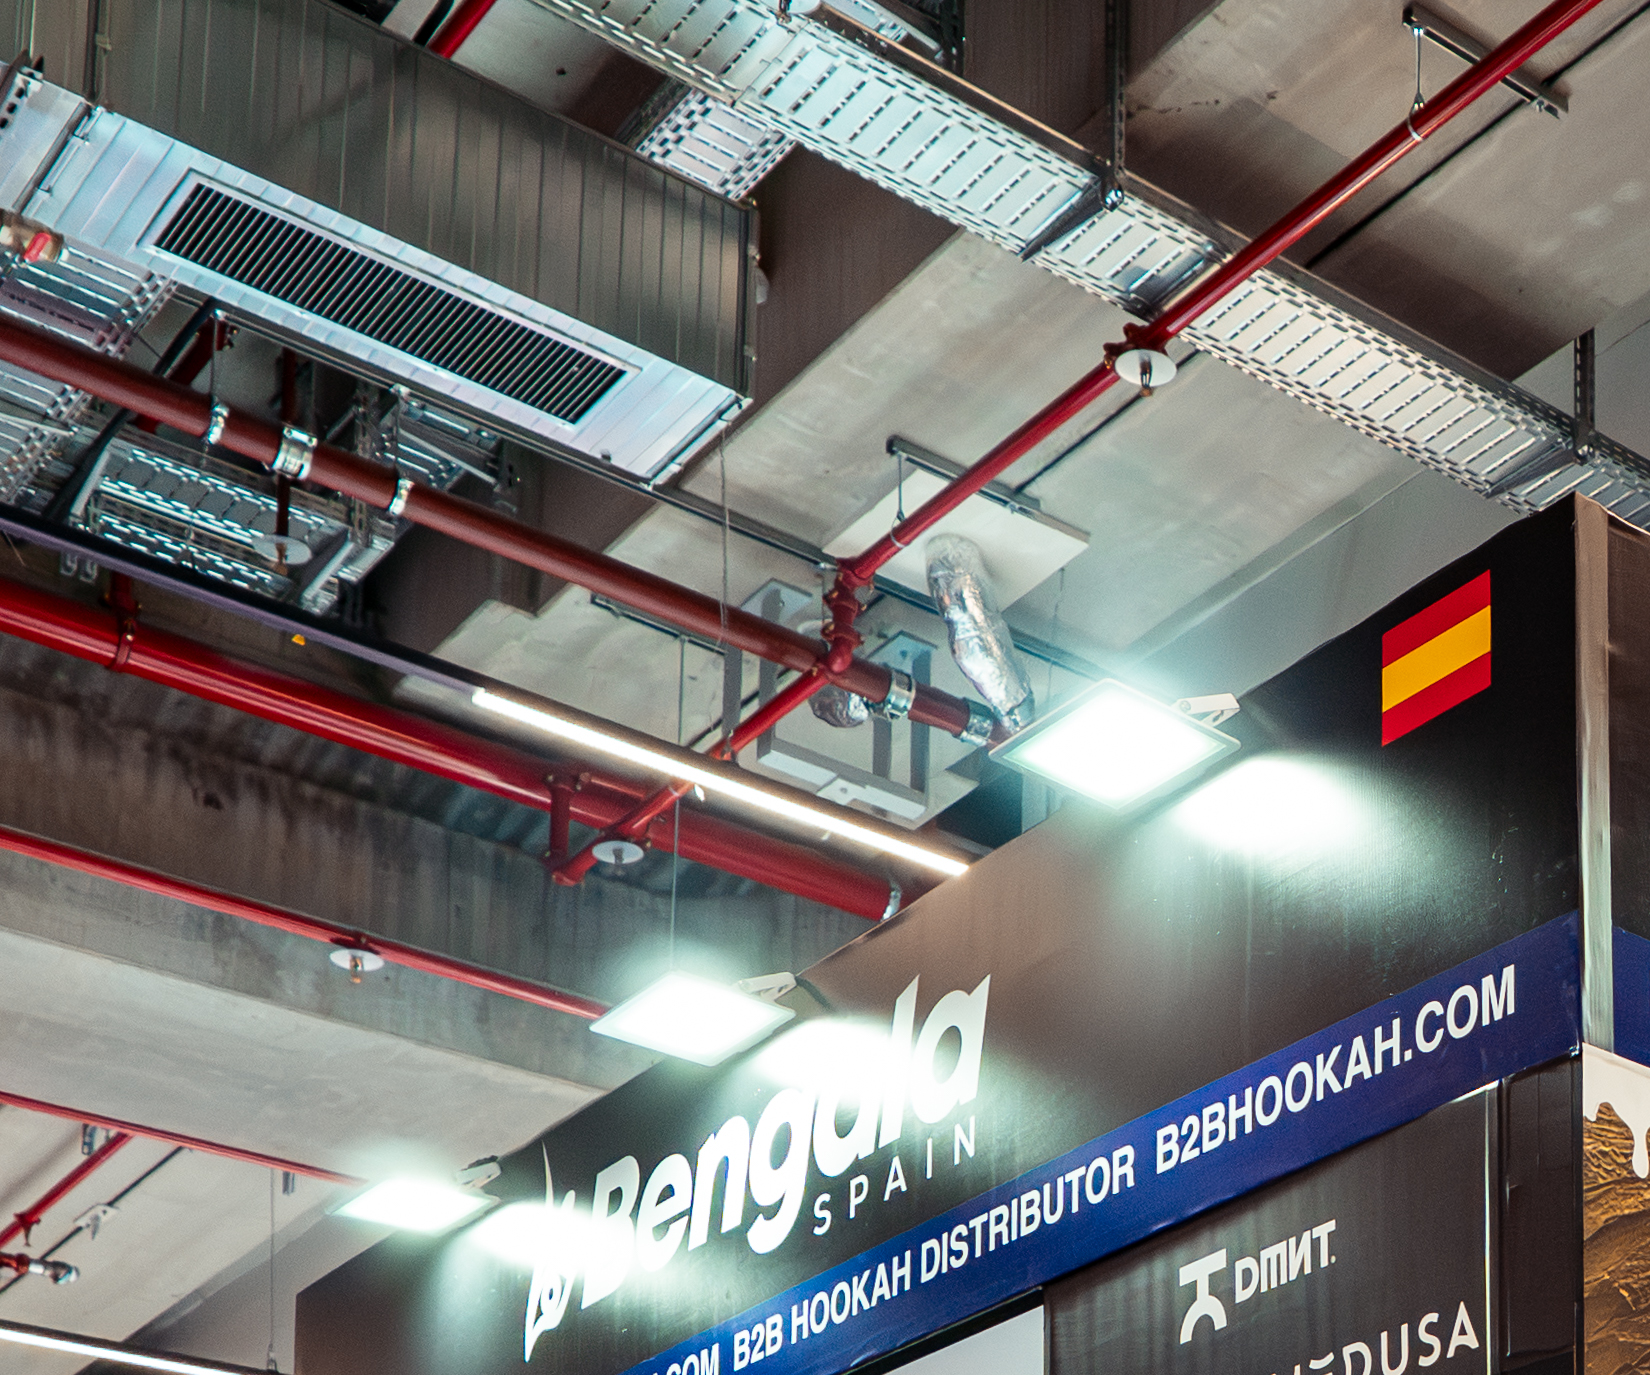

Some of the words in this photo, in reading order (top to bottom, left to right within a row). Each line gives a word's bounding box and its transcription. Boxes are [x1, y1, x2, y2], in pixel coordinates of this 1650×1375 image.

[733, 1312, 783, 1374] B2B
[790, 1251, 911, 1344] HOOKAH
[920, 1146, 1134, 1285] DISTRIBUTOR
[1156, 964, 1516, 1174] B2BHOOKAH.COM
[813, 1115, 976, 1237] SPAIN
